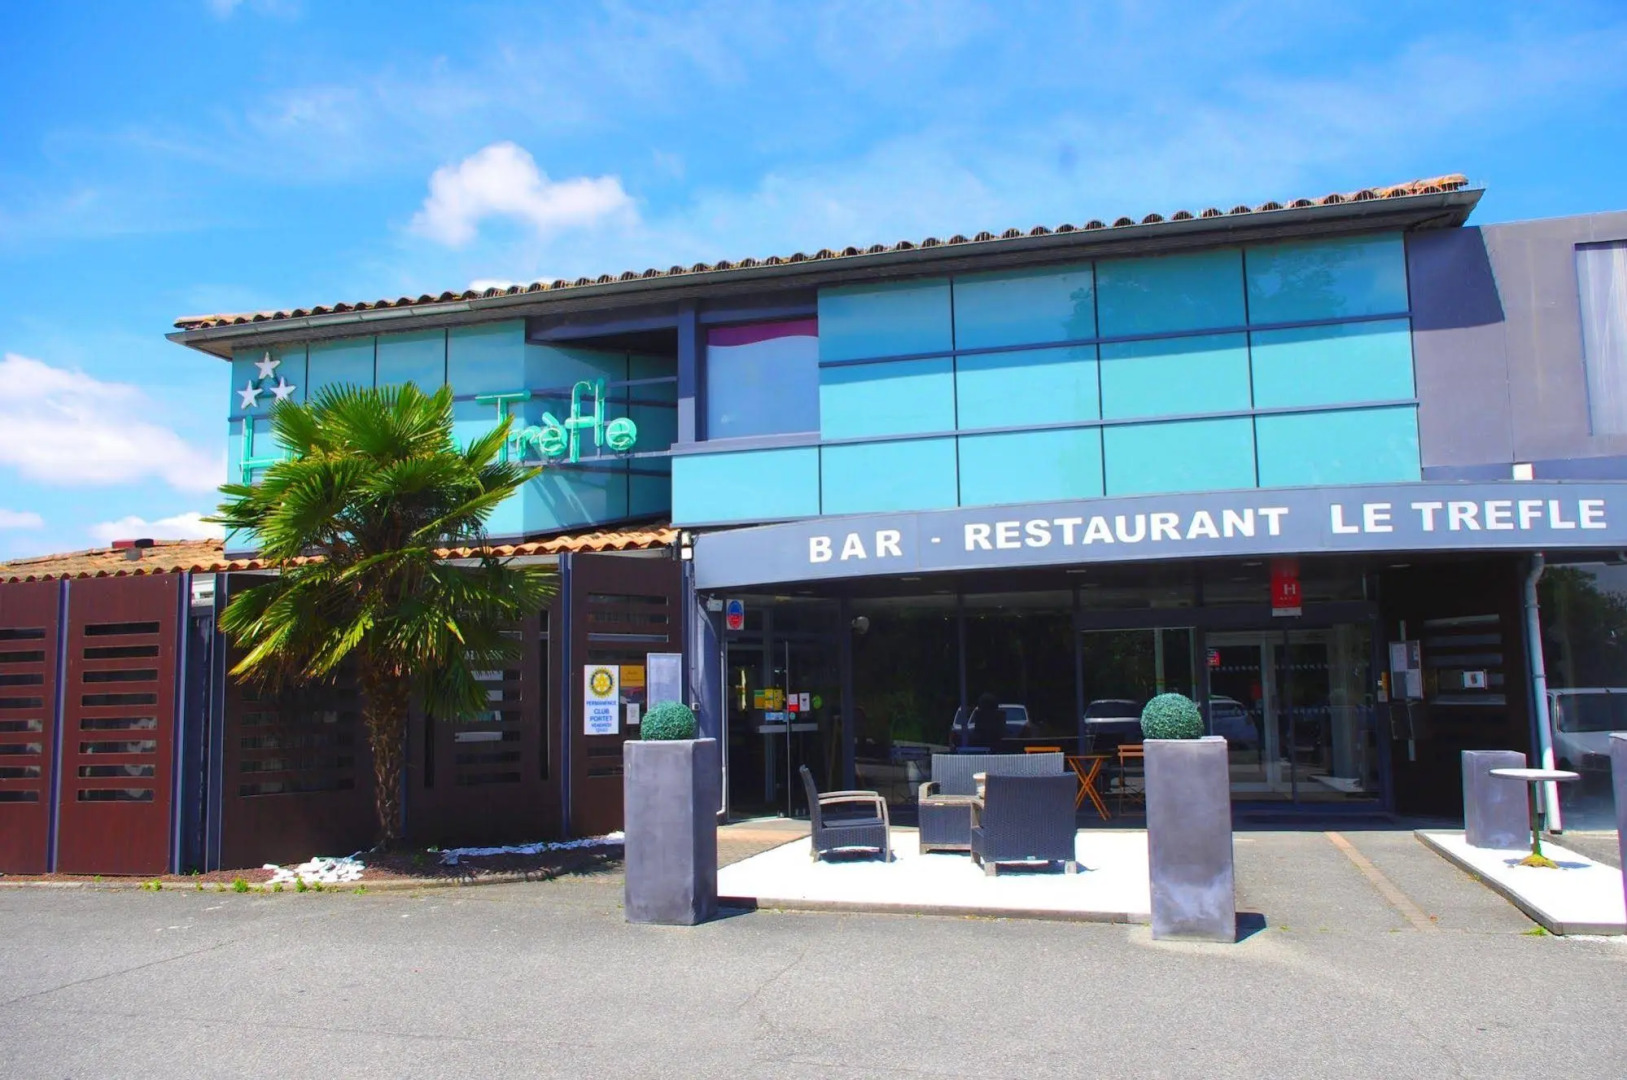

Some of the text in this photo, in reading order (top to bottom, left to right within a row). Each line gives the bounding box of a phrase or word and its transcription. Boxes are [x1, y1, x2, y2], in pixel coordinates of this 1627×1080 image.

[475, 377, 637, 464] Trèfle
[809, 529, 903, 563] BAR
[964, 507, 1289, 551] RESTAURANT
[1331, 503, 1393, 535] LE
[1411, 500, 1607, 532] TREFLE
